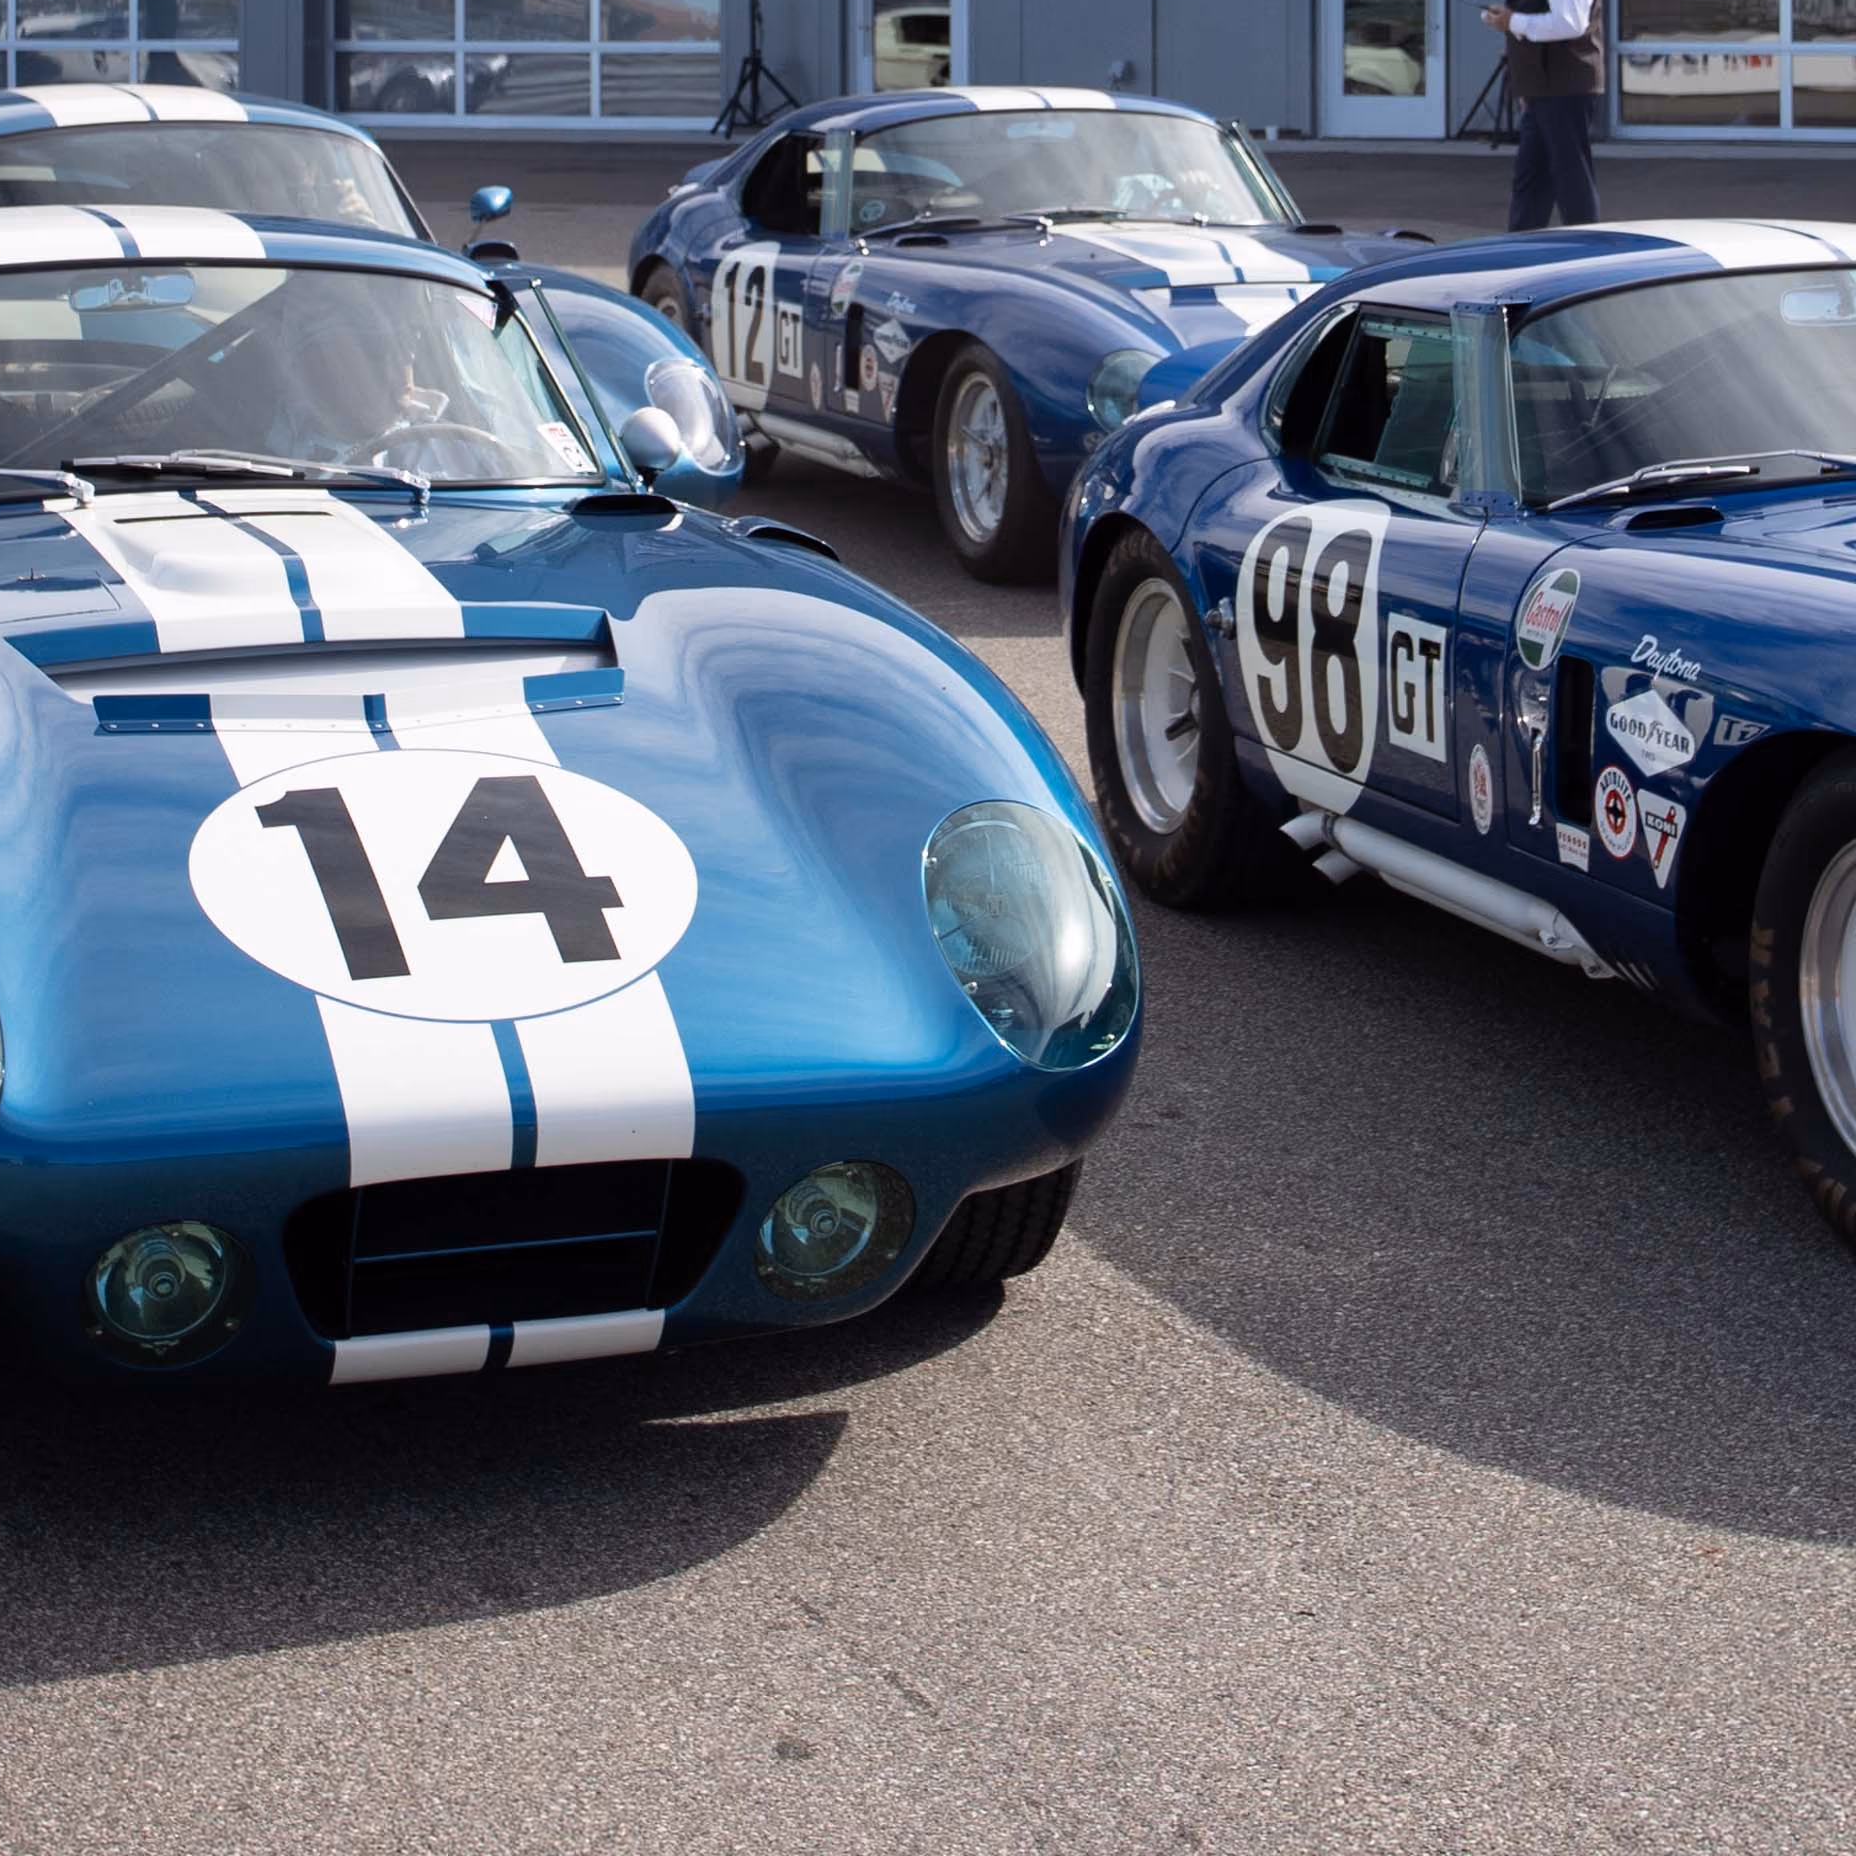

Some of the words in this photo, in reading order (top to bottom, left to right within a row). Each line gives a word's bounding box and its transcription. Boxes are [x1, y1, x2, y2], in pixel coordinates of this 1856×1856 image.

[724, 261, 765, 385] 12
[779, 310, 800, 369] GT
[1253, 515, 1373, 774] 98
[1526, 591, 1573, 633] Castrol
[1631, 634, 1701, 681] Daytona
[1390, 630, 1441, 744] GT
[254, 774, 625, 981] 14
